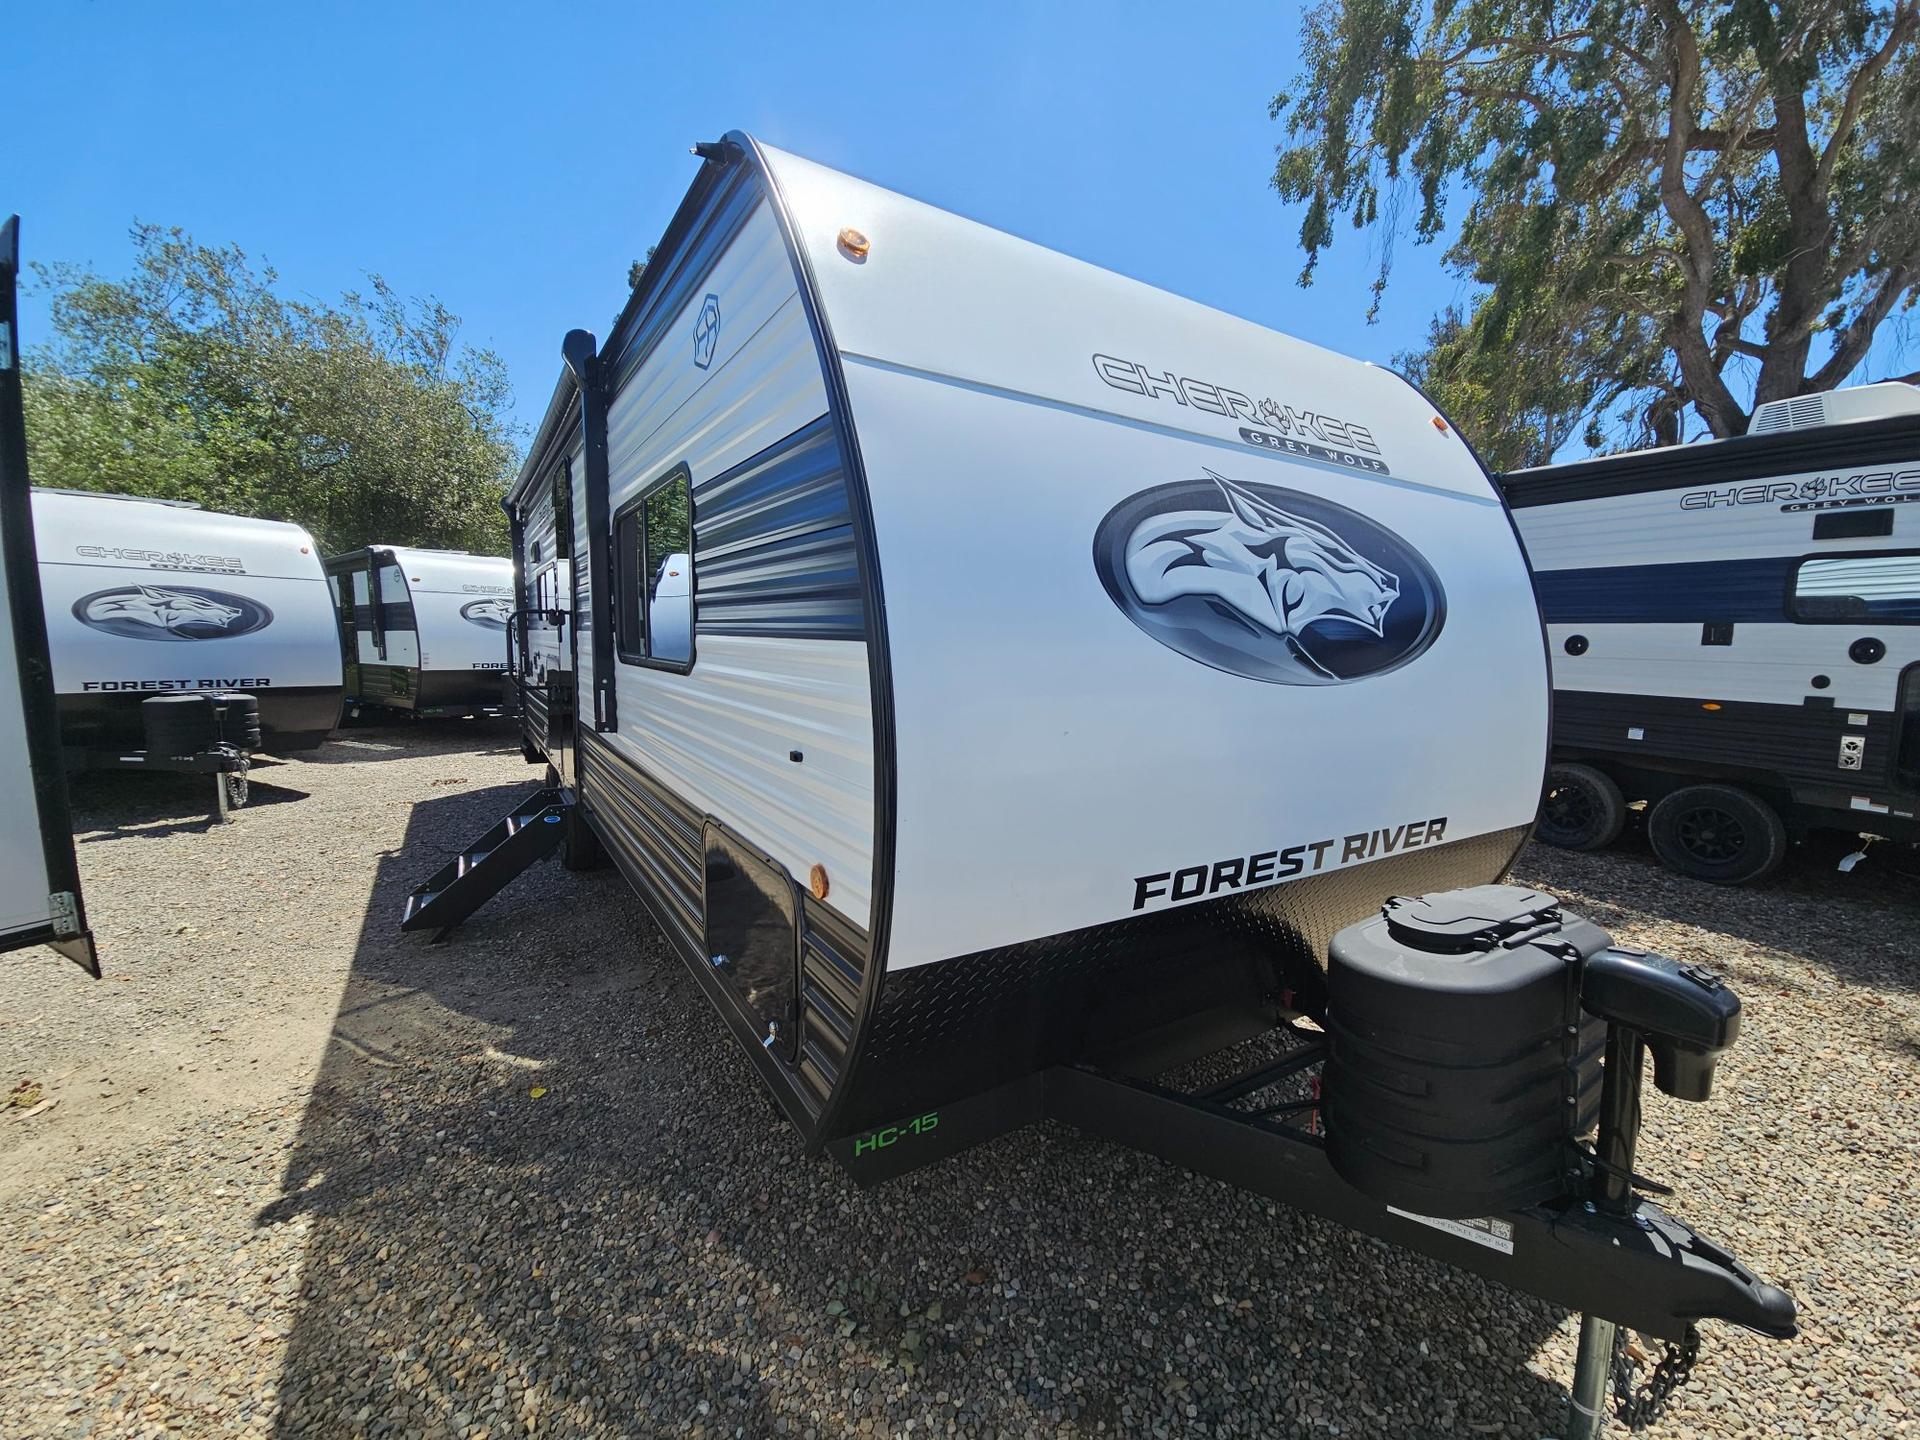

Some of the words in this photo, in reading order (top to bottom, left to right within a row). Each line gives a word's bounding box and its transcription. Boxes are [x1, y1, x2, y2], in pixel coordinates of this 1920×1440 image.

[1250, 432, 1310, 455] GREY
[1325, 449, 1380, 471] WOLF
[1790, 499, 1848, 511] GREY
[1865, 494, 1912, 504] WOL
[82, 679, 191, 692] FOREST
[198, 678, 271, 689] RIVER
[1133, 839, 1335, 911] FOREST
[1341, 816, 1448, 864] RIVER
[855, 1111, 939, 1157] HC-15
